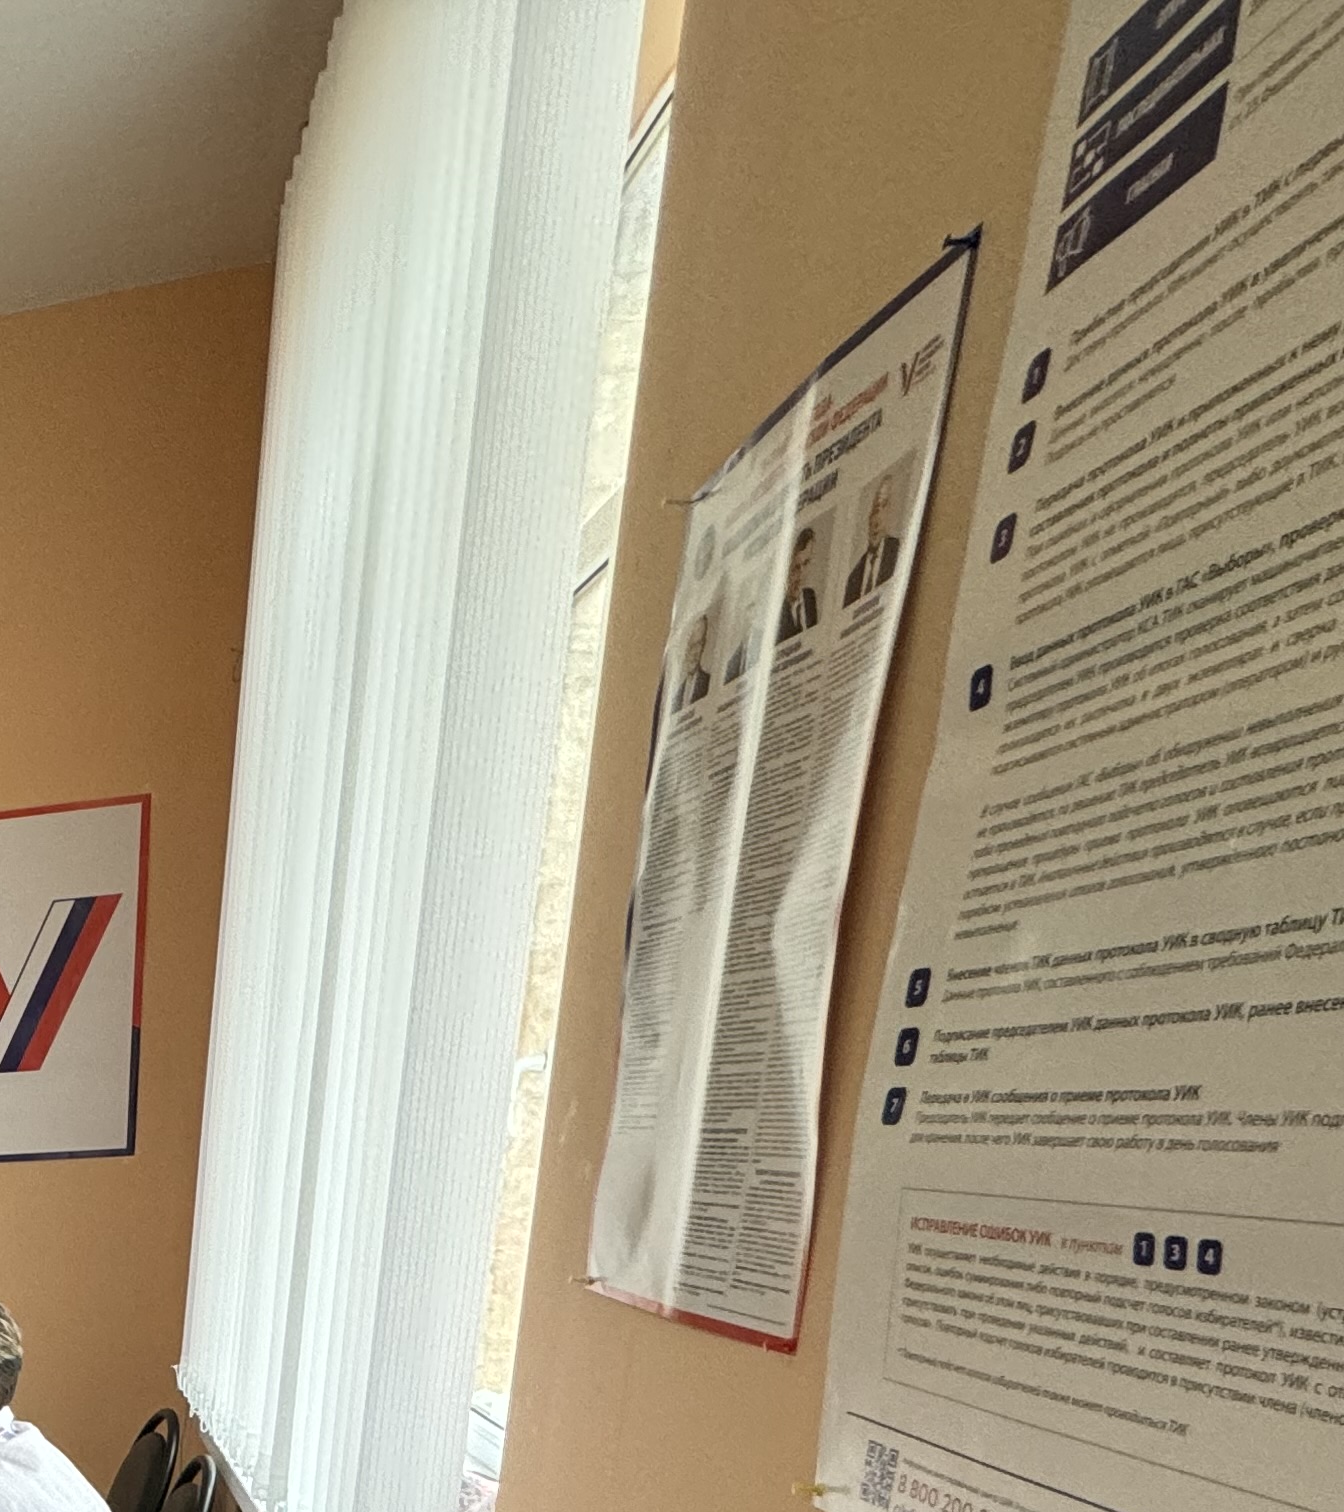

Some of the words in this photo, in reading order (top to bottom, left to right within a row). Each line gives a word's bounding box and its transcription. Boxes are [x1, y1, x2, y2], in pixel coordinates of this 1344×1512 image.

[1200, 926, 1261, 945] сводную
[1266, 916, 1327, 935] таблицу
[914, 980, 923, 996] 5
[1247, 1002, 1293, 1020] ранее
[902, 1039, 912, 1054] 6
[1111, 1089, 1171, 1103] протокола
[1170, 1085, 1202, 1100] УИК
[890, 1097, 898, 1114] 7
[1281, 1111, 1311, 1126] УИК
[911, 1218, 978, 1237] ИСПРАВЛЕНИЕ
[979, 1225, 1026, 1243] ОШИБОК
[1029, 1231, 1052, 1246] УИК
[1140, 1241, 1148, 1257] 1
[1170, 1245, 1180, 1260] 3
[1204, 1248, 1215, 1265] 4
[1255, 1297, 1310, 1314] законом
[1317, 1302, 1344, 1323] (уст
[1221, 1340, 1260, 1356] ранее
[1216, 1363, 1276, 1383] протокол
[1281, 1373, 1308, 1390] УИК
[1314, 1383, 1323, 1395] с
[1259, 1397, 1297, 1414] члена
[897, 1474, 908, 1494] 8
[910, 1482, 938, 1508] 800
